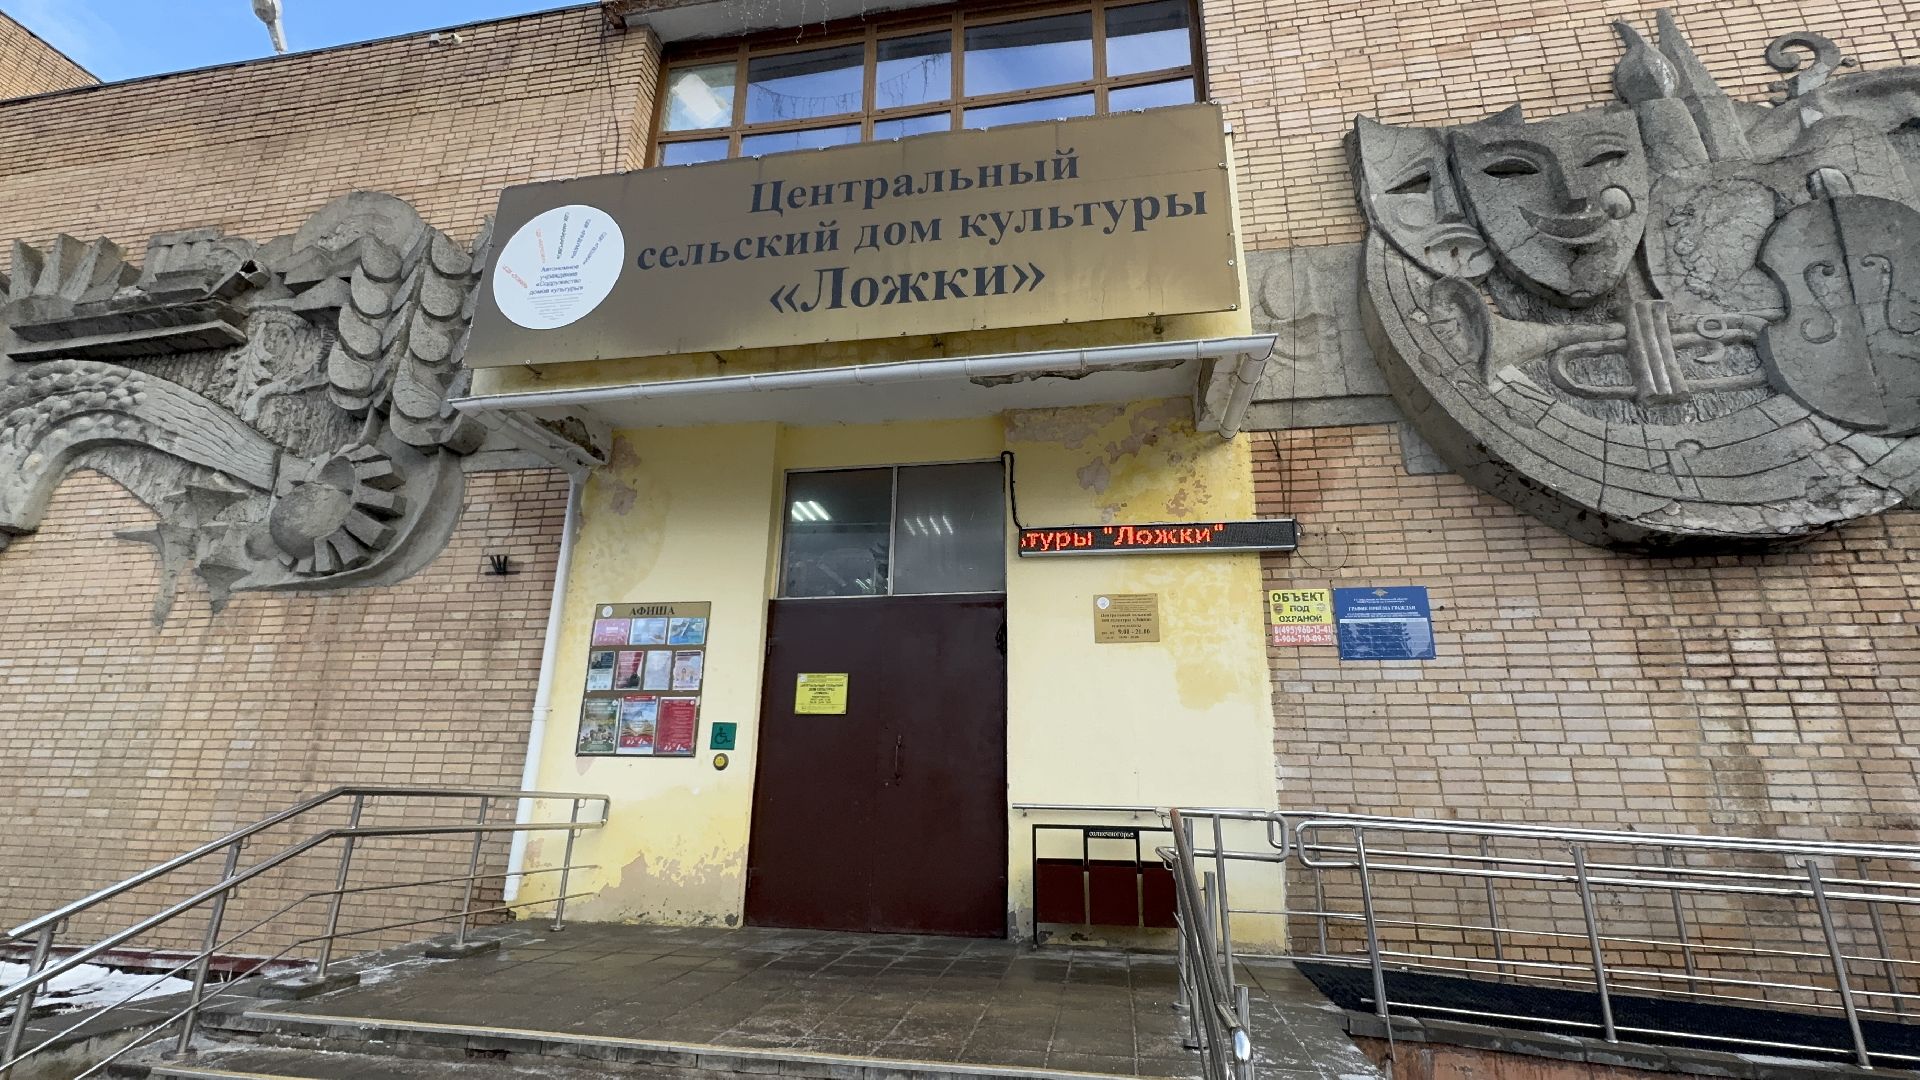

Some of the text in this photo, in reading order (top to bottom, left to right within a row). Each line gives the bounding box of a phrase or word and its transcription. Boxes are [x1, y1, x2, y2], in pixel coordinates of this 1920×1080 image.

[749, 148, 1081, 213] Центральный
[637, 189, 1208, 272] сельский дом культуры
[769, 261, 1046, 314] «Ложки»
[1103, 523, 1224, 546] "Ложки"
[1272, 592, 1324, 602] ОБЪЕКТ
[629, 605, 675, 616] АФИША
[1289, 605, 1310, 613] ПОД
[1279, 614, 1323, 622] ОХРАНОЙ
